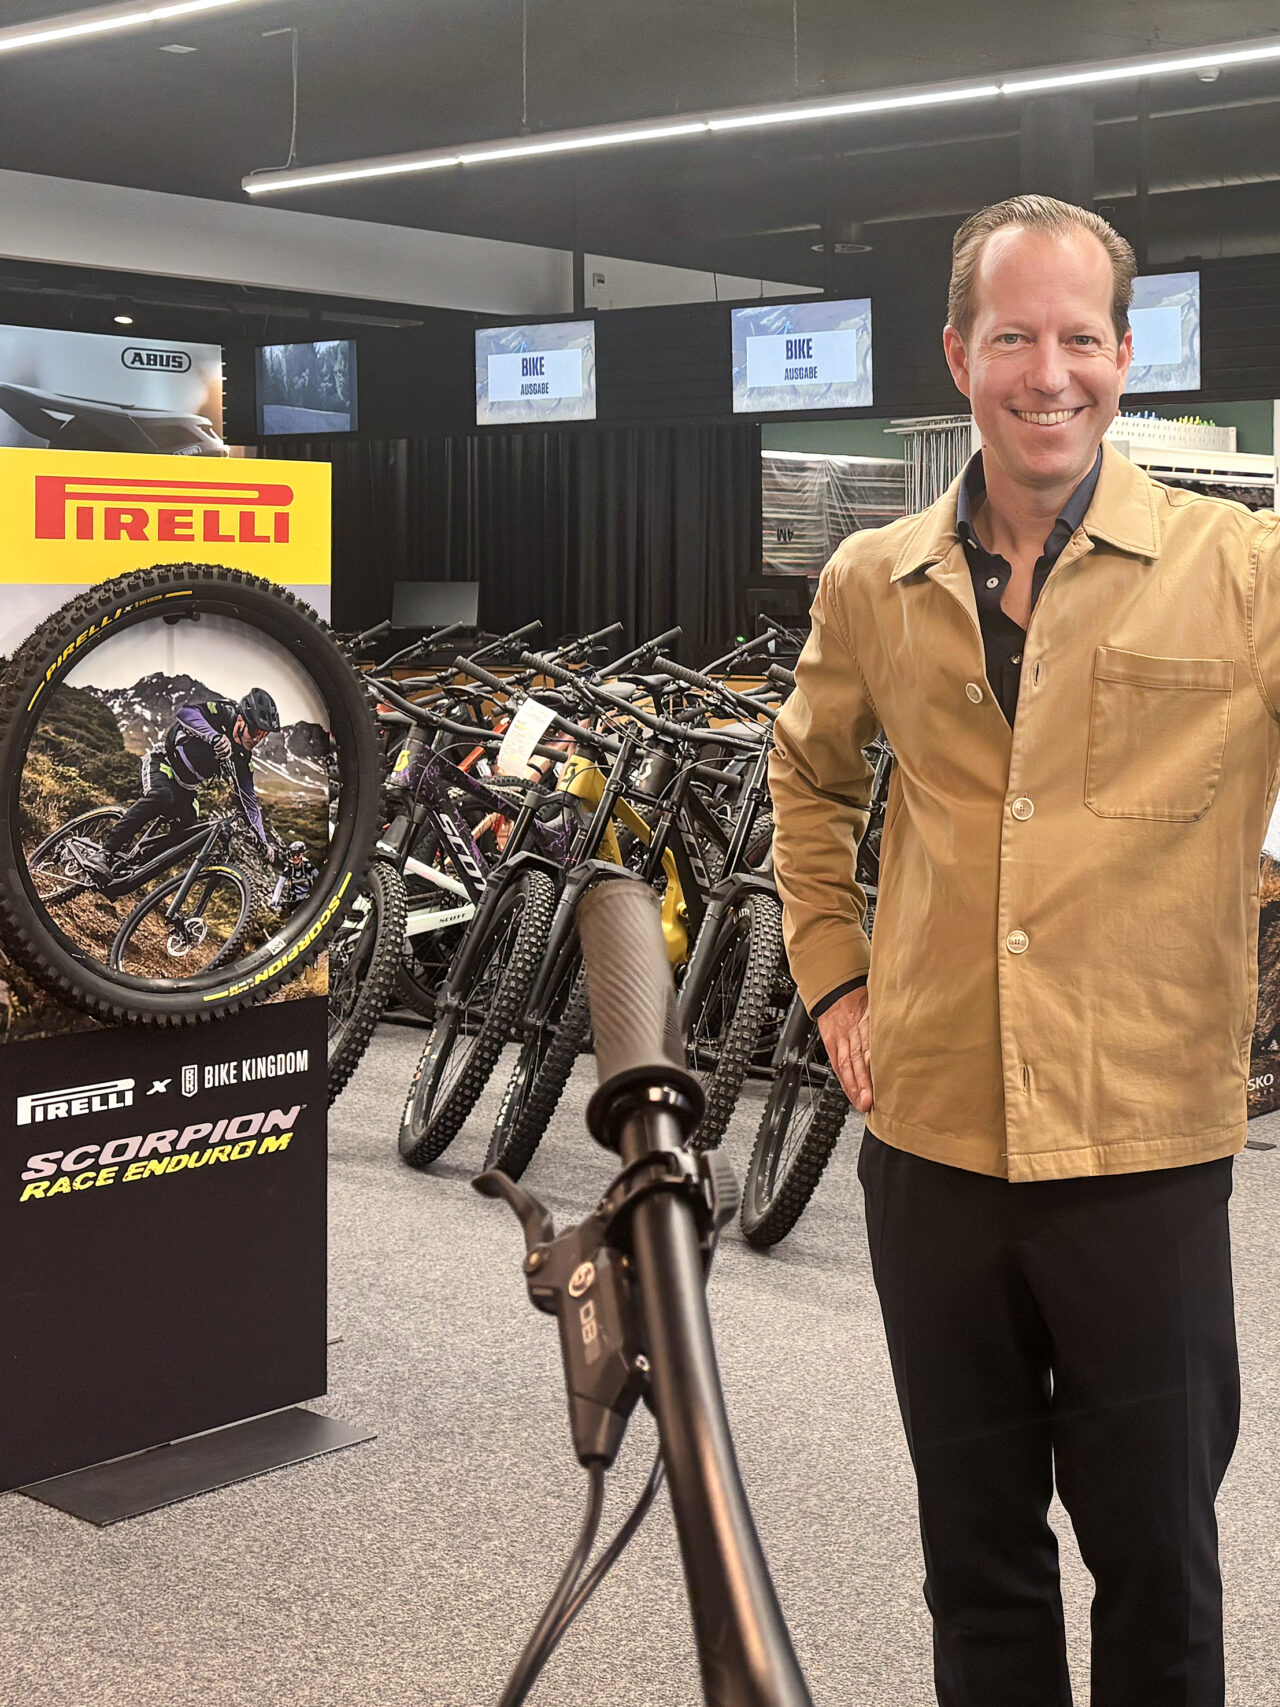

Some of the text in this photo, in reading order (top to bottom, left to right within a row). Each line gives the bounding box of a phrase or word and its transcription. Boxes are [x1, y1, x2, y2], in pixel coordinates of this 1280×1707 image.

[130, 352, 183, 369] ABUS
[521, 356, 545, 377] BIKE
[786, 338, 813, 360] BIKE
[520, 383, 549, 396] AUSGABE
[784, 366, 818, 381] AUSGABE
[35, 475, 294, 544] PIRELLI
[46, 608, 122, 682] PIRELLI
[255, 895, 341, 986] SCORPION
[17, 1078, 136, 1126] PIRELLI
[204, 1061, 238, 1089] BIKE
[242, 1049, 309, 1082] KINGDOM
[1246, 1073, 1275, 1092] SKO
[21, 1104, 302, 1181] SCORPION
[19, 1132, 294, 1202] RACE ENDURO M
